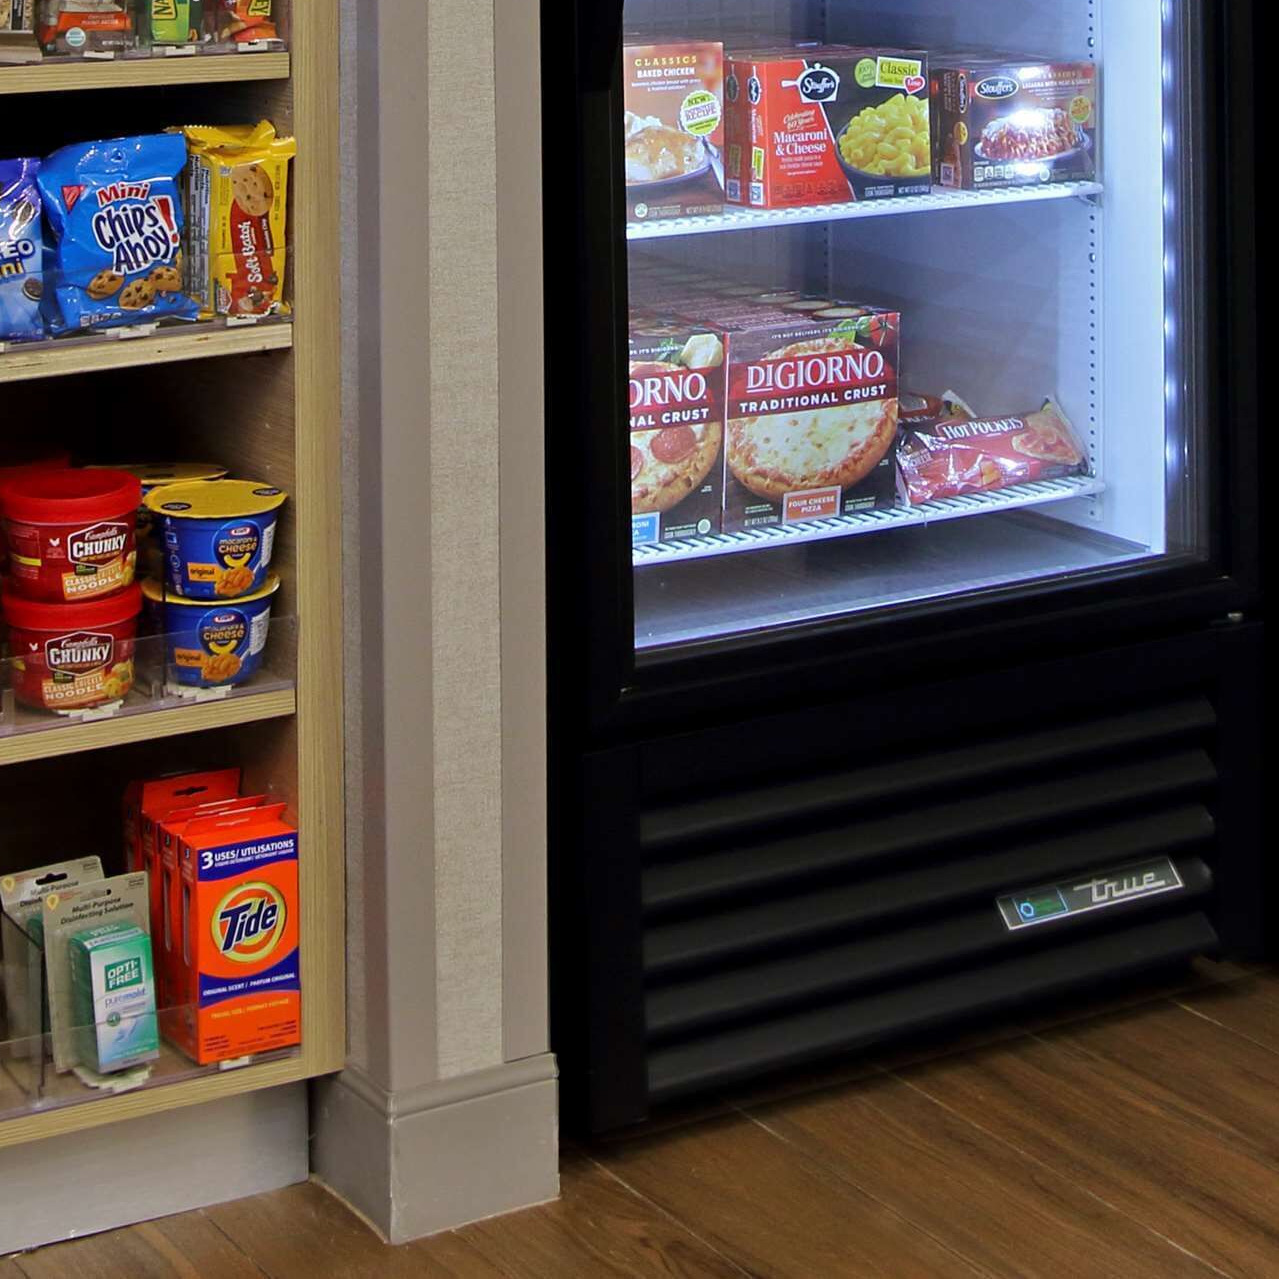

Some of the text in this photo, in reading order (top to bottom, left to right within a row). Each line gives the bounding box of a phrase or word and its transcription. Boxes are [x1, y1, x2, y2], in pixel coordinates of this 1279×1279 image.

[634, 55, 697, 67] CLASSICS
[880, 62, 918, 76] Classic
[637, 66, 695, 79] BAKED CHICKEN
[774, 128, 828, 145] Macaroni
[775, 142, 826, 156] & Cheese
[98, 184, 150, 208] Mini
[94, 203, 157, 249] Chips
[238, 220, 263, 283] Soft Batch
[740, 385, 887, 412] TRADITIONAL CRUST
[662, 408, 709, 423] CRUST
[942, 425, 969, 440] HOT
[801, 504, 822, 513] PIZZA
[72, 533, 126, 558] CHUNKY
[49, 643, 110, 665] CHUNKY
[45, 683, 105, 700] NOODLE
[201, 851, 214, 870] 3
[241, 839, 294, 857] UTILISATIONS
[1073, 872, 1166, 902] true
[72, 897, 121, 913] Multi-Purpose
[219, 899, 278, 953] Tide
[107, 961, 138, 979] OPTI-
[108, 970, 139, 989] FREE
[203, 983, 245, 996] ORIGINAL SCENT
